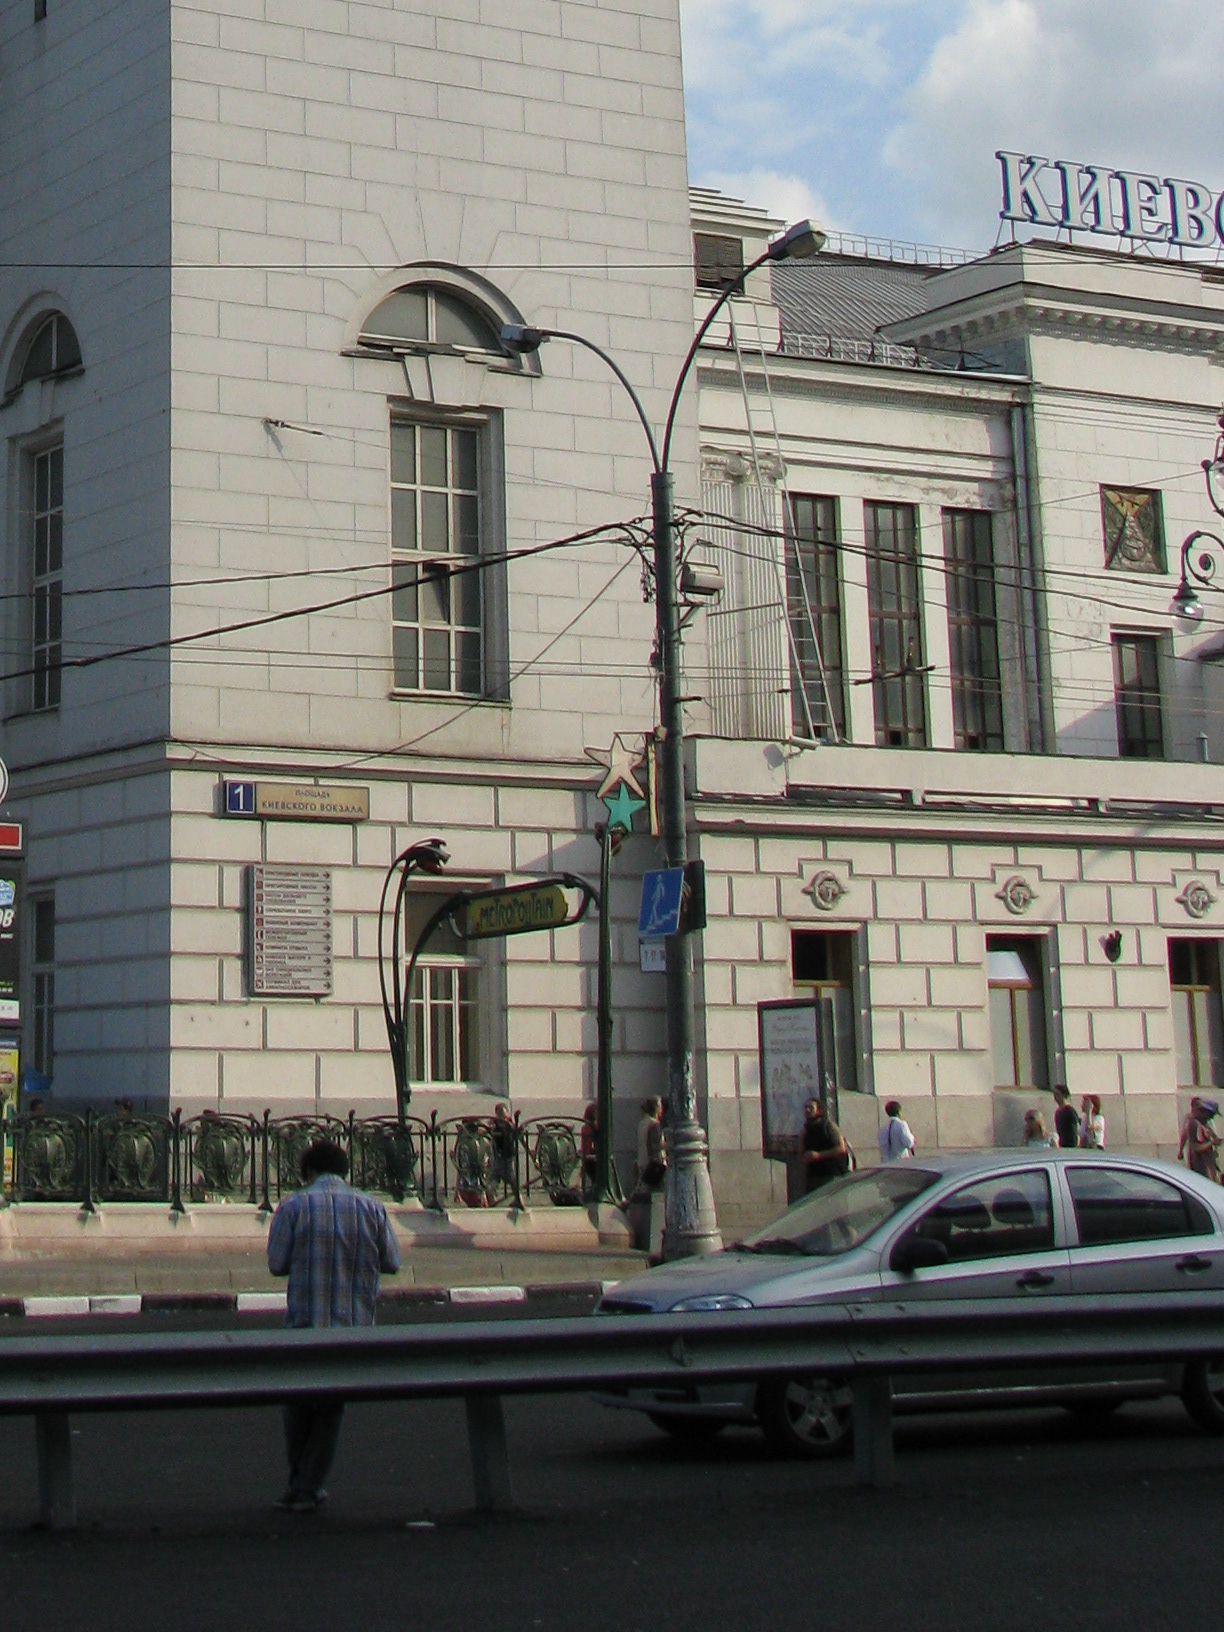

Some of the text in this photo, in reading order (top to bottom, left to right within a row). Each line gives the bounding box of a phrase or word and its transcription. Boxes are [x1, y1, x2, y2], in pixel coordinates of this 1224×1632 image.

[995, 150, 1224, 248] КИЕВ
[234, 784, 244, 810] 1
[262, 801, 363, 814] КИЕВСКОГО ВОКЗАЛА
